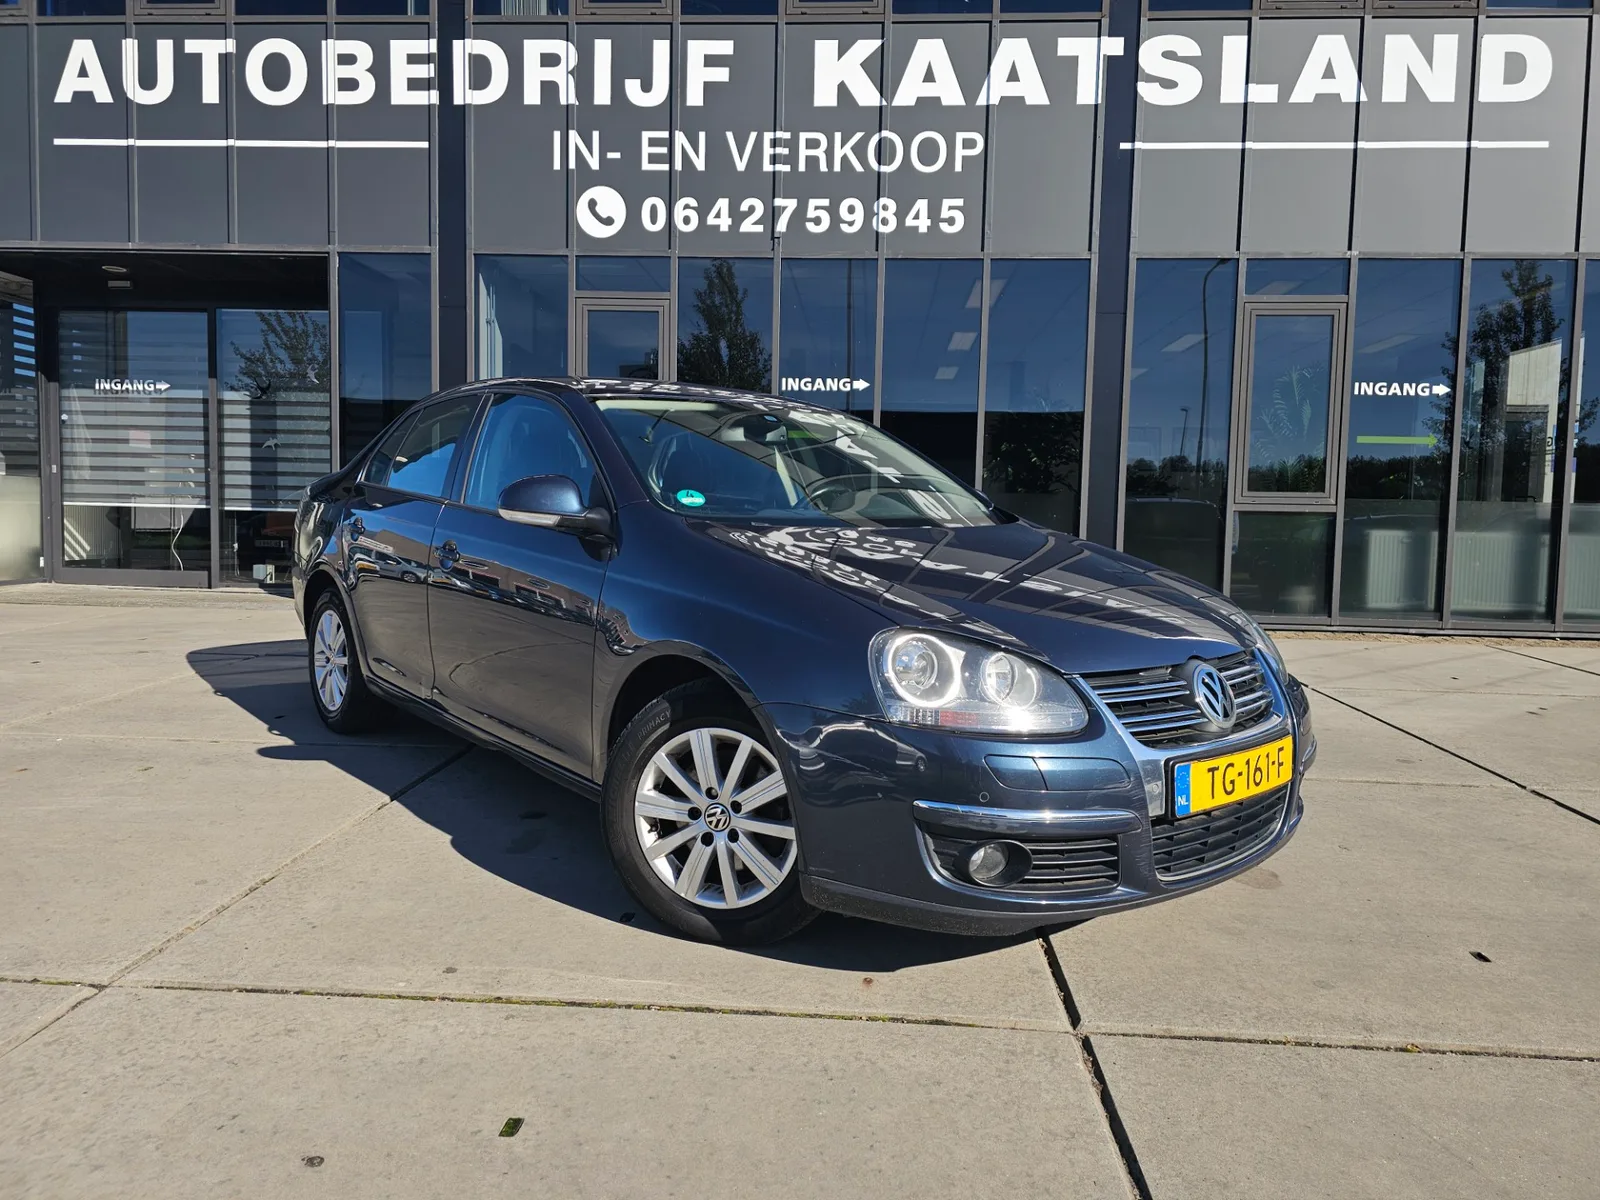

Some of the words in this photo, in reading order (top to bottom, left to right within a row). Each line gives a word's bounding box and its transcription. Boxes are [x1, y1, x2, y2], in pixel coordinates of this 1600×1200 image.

[53, 38, 734, 107] AUTOBEDRIJF
[813, 34, 1554, 106] KAATSLAND
[553, 129, 622, 171] IN-
[641, 130, 706, 172] EN
[725, 130, 985, 173] VERKOOP
[641, 196, 965, 234] 0642759845
[95, 378, 155, 391] INGANG
[781, 377, 851, 392] INGANG
[1353, 381, 1430, 396] INGANG
[636, 709, 672, 740] PRIMACY
[1207, 746, 1284, 800] TG-161-F
[1177, 794, 1189, 806] NL
